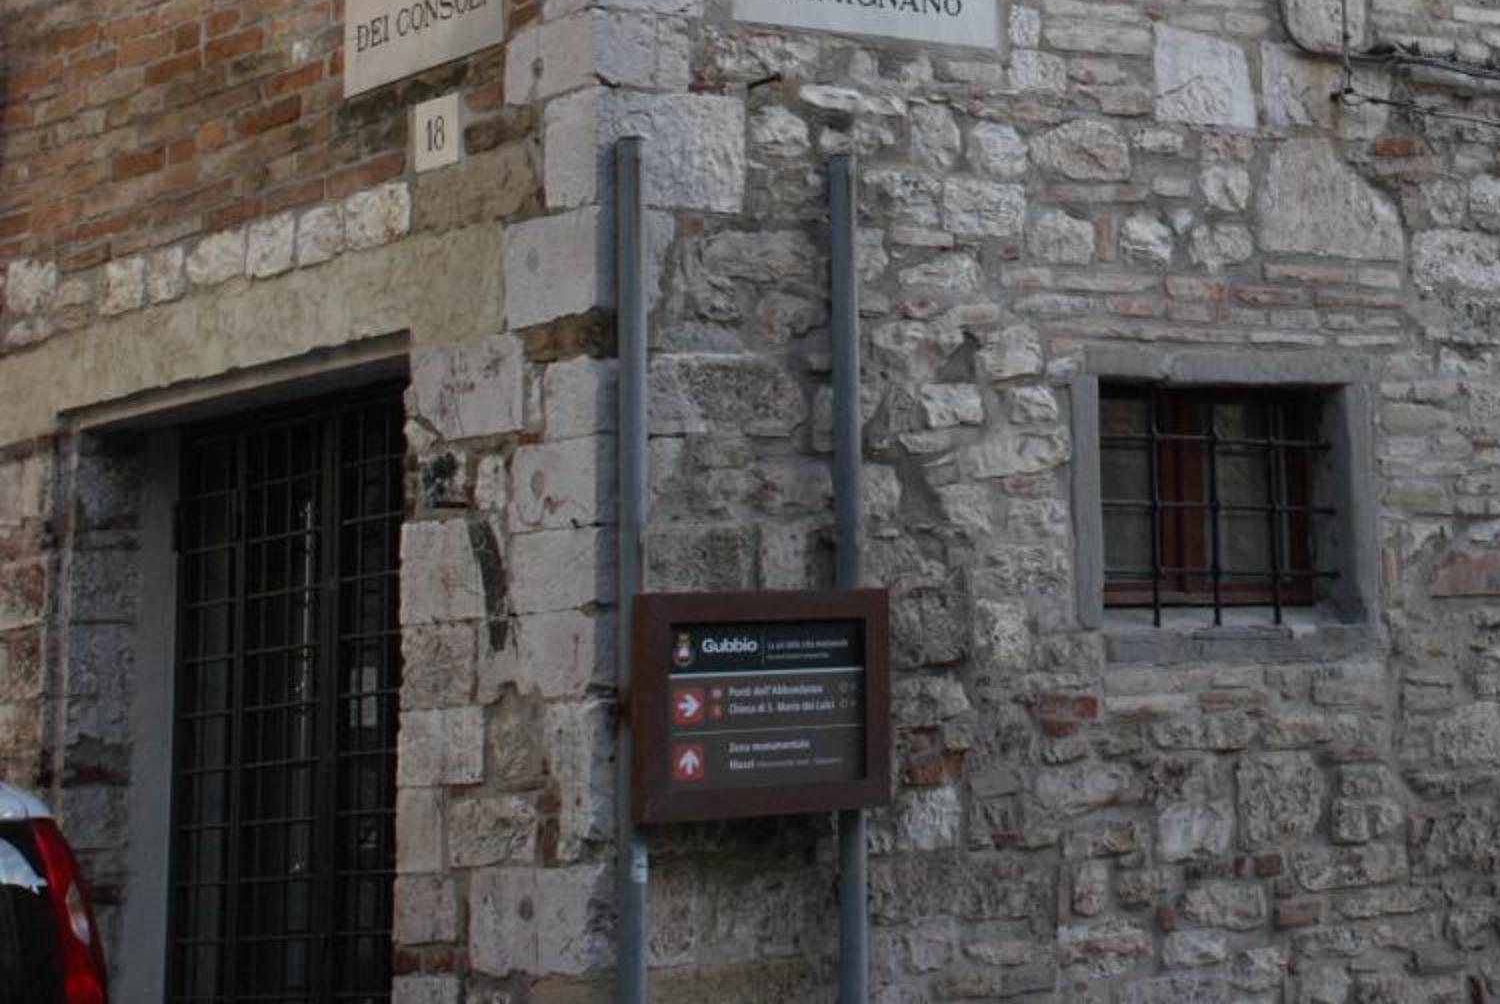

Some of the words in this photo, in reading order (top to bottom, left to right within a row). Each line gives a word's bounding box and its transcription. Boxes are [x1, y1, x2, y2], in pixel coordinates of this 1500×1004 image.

[356, 14, 390, 53] DEI
[424, 115, 447, 152] 18
[702, 637, 759, 655] Gubbio
